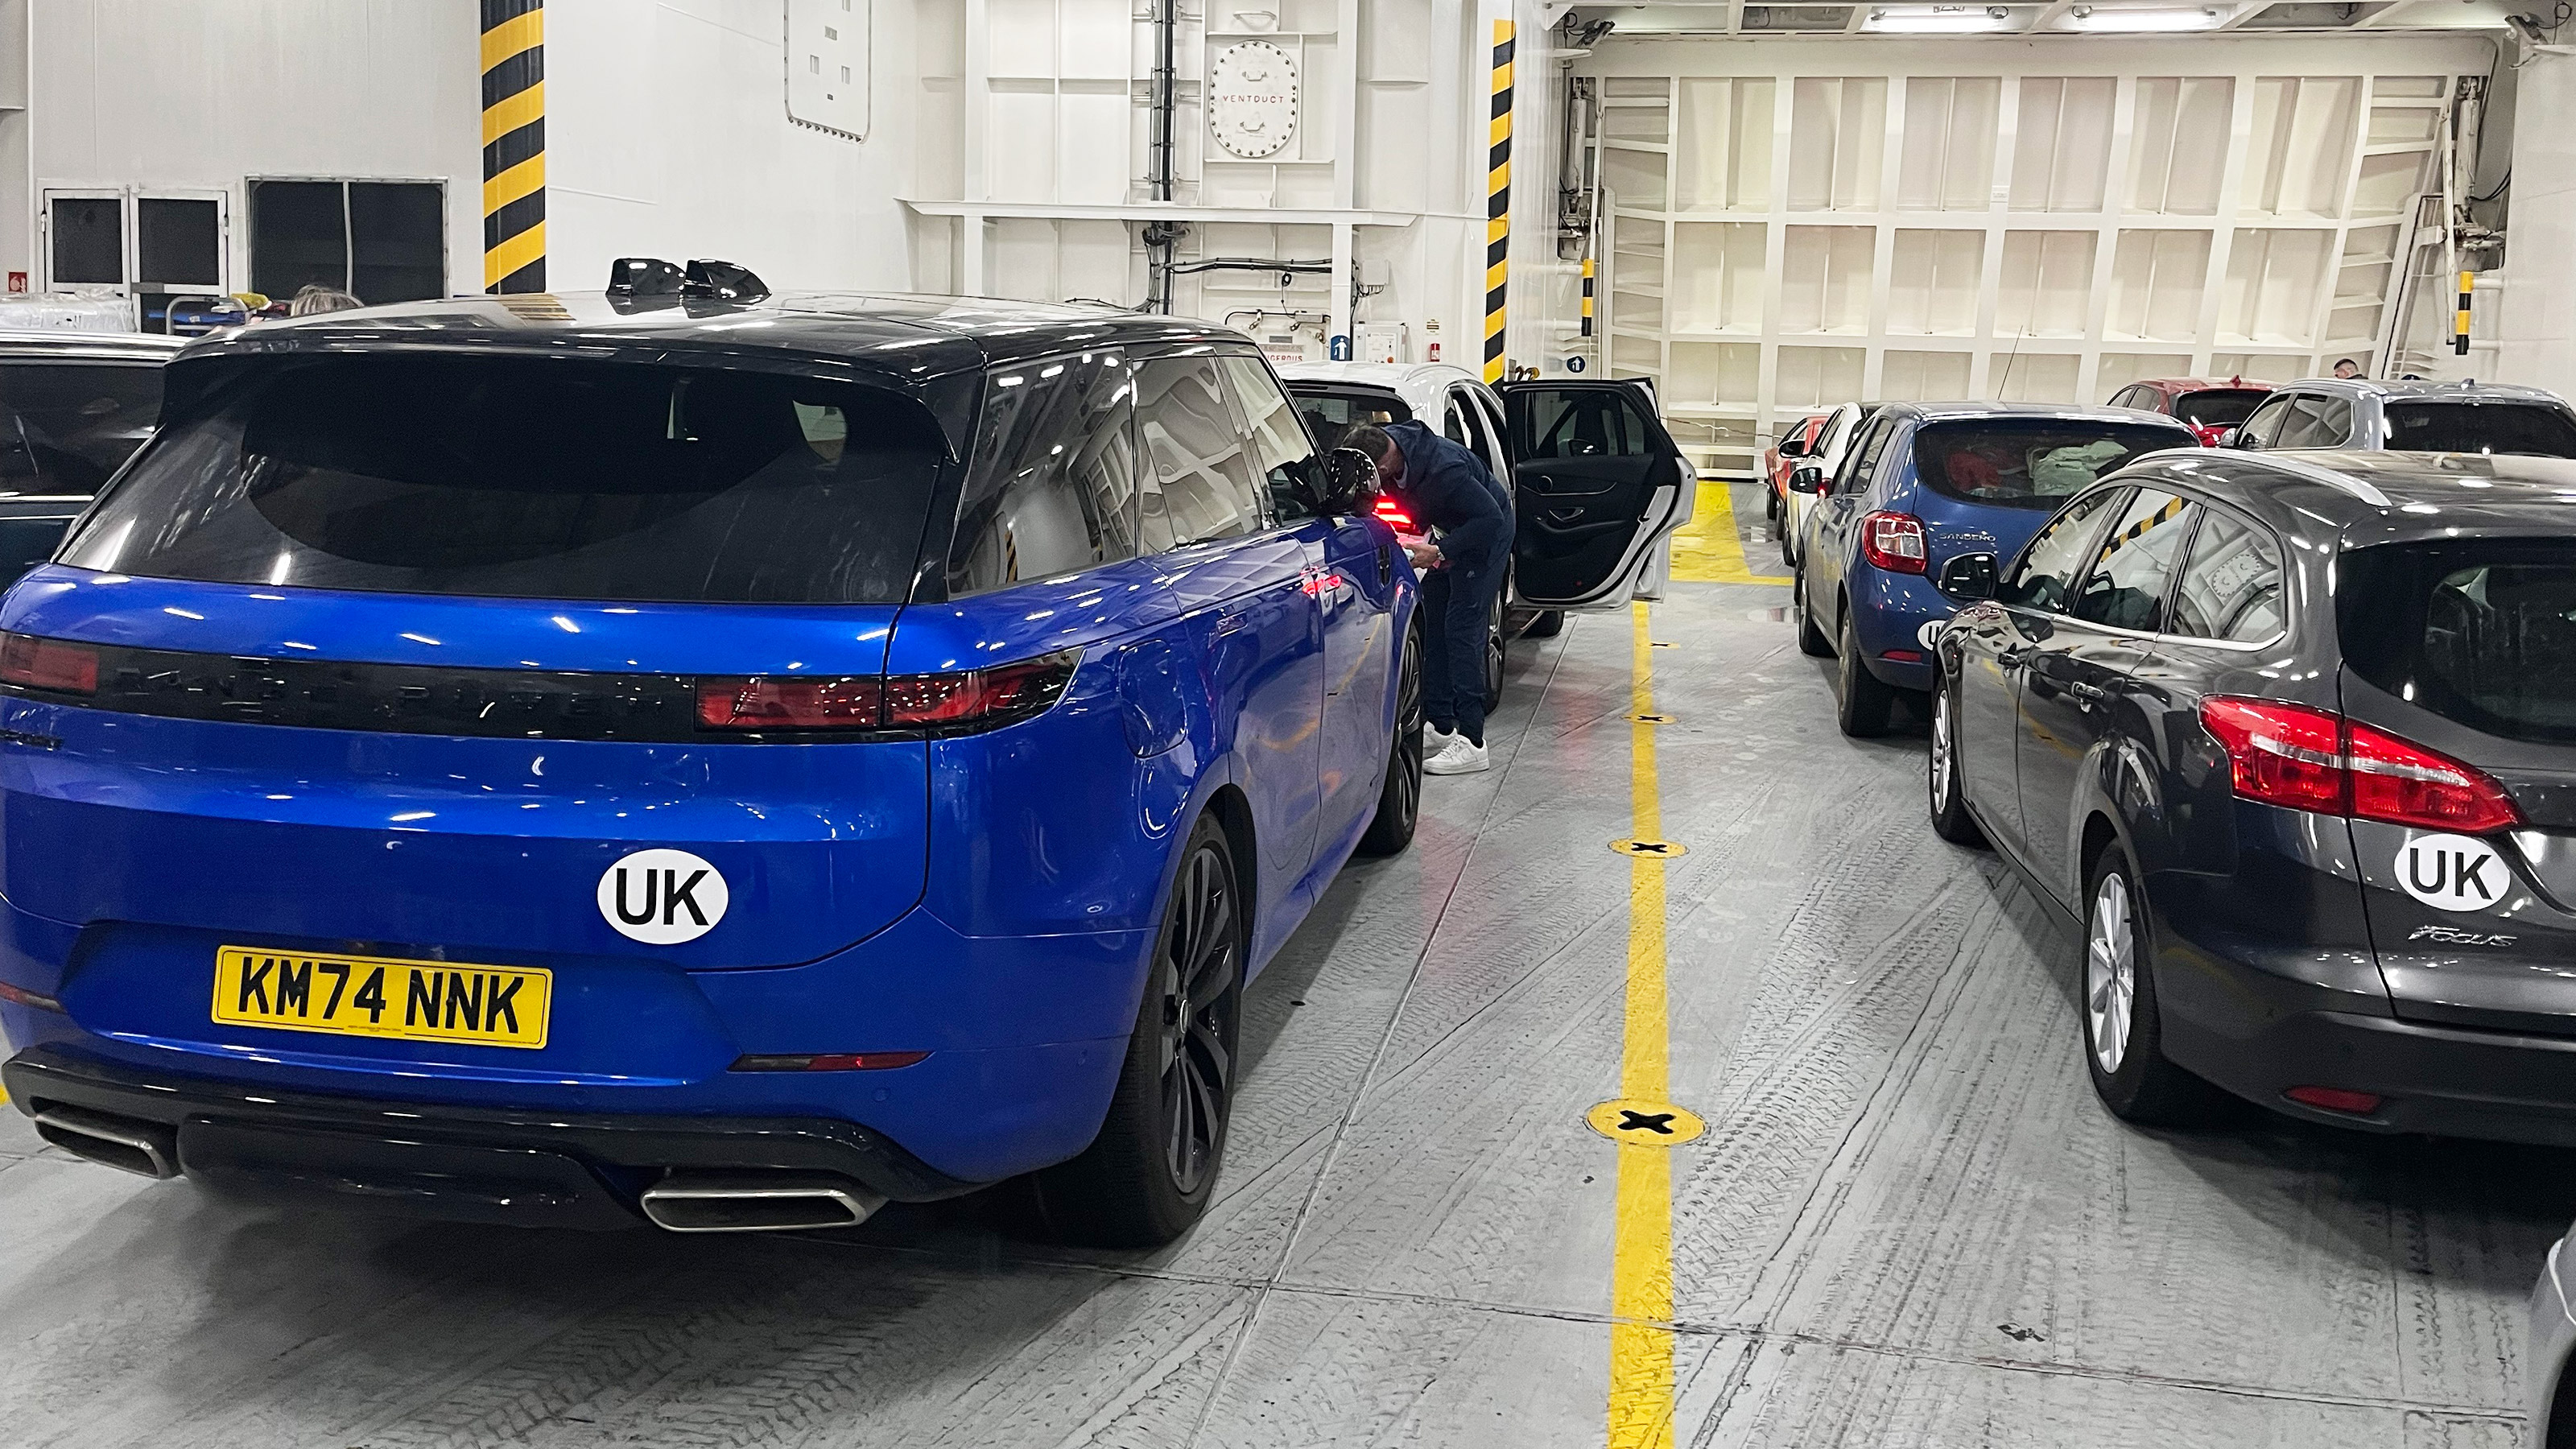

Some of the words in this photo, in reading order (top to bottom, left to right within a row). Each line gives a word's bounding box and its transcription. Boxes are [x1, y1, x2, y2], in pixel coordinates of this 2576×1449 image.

[1223, 95, 1284, 104] VENTDUCT
[1267, 354, 1302, 362] GEROUS
[1939, 533, 1996, 542] SANDERO
[2409, 848, 2493, 900] UK
[616, 867, 710, 927] UK
[238, 956, 386, 1023] KM74
[405, 968, 524, 1034] NNK
